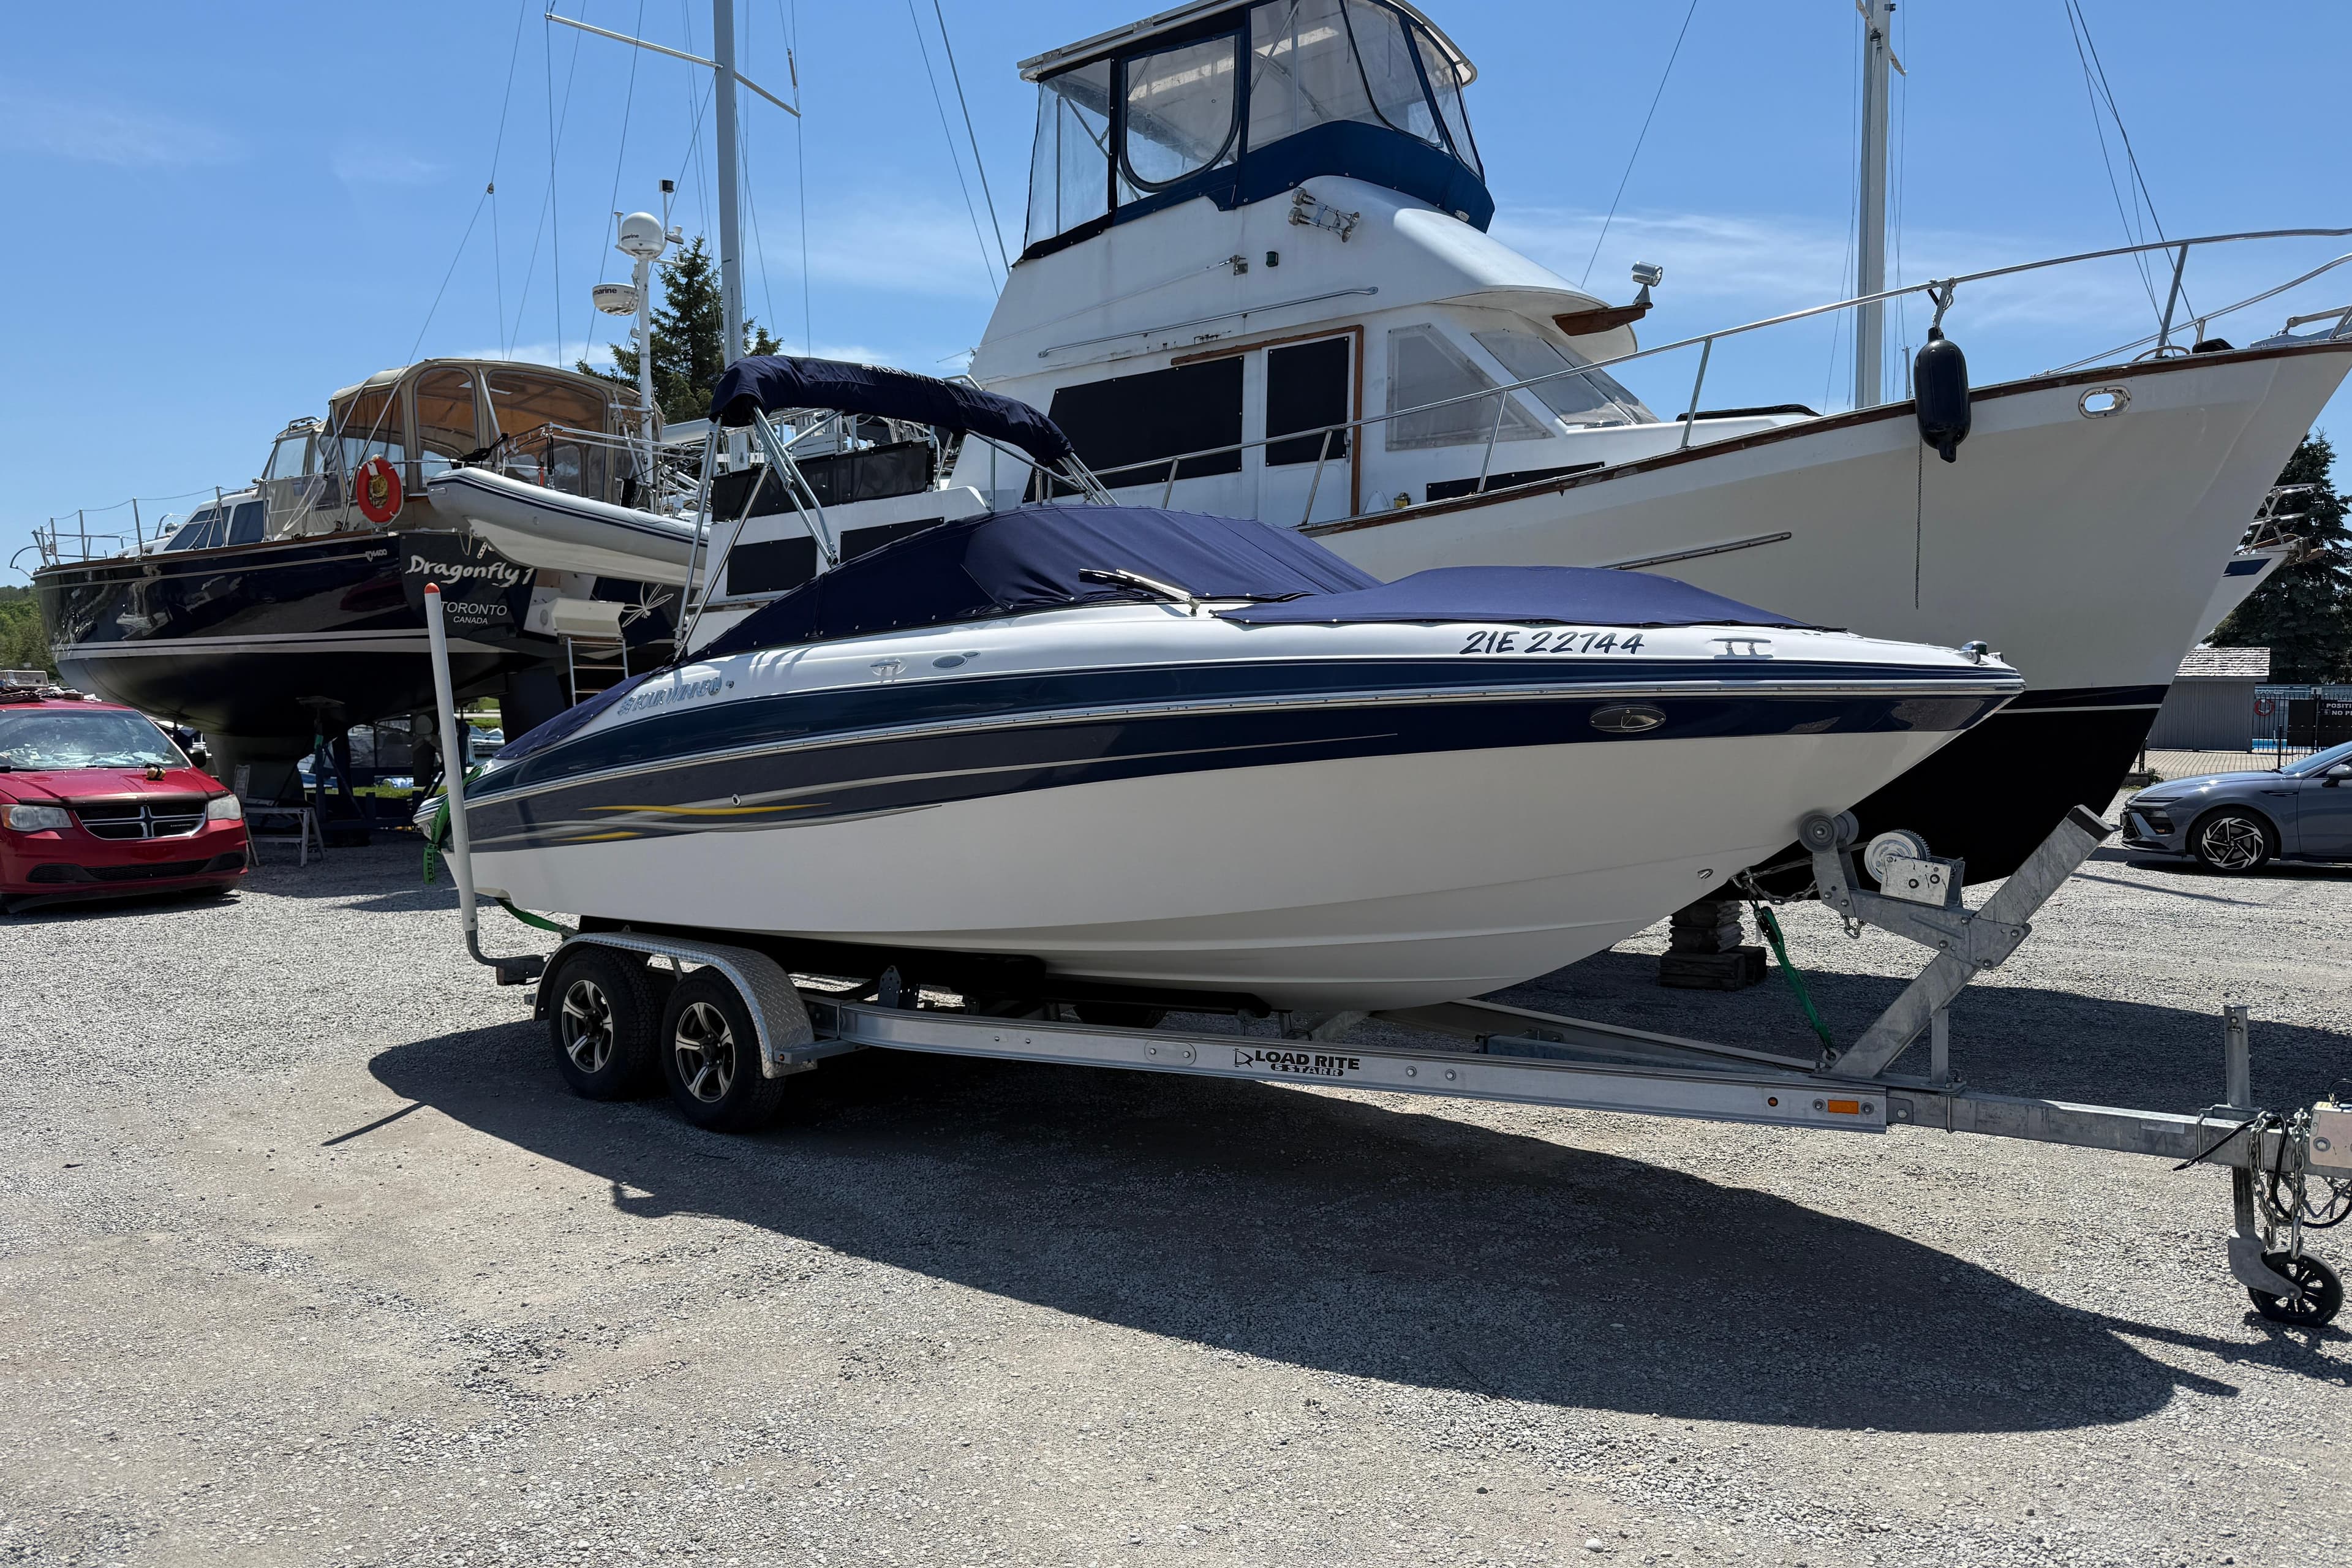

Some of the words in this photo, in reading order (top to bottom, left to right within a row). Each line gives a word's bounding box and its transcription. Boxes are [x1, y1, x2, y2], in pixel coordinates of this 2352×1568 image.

[405, 554, 520, 588] Dragonfly
[522, 568, 535, 584] 1
[441, 601, 507, 616] TORONTO
[453, 616, 488, 625] CANADA
[1459, 630, 1520, 654] 21E
[1524, 631, 1645, 655] 22744
[1256, 1050, 1310, 1065] LOAD
[1315, 1055, 1360, 1070] RITE
[1287, 1065, 1340, 1076] STARR
